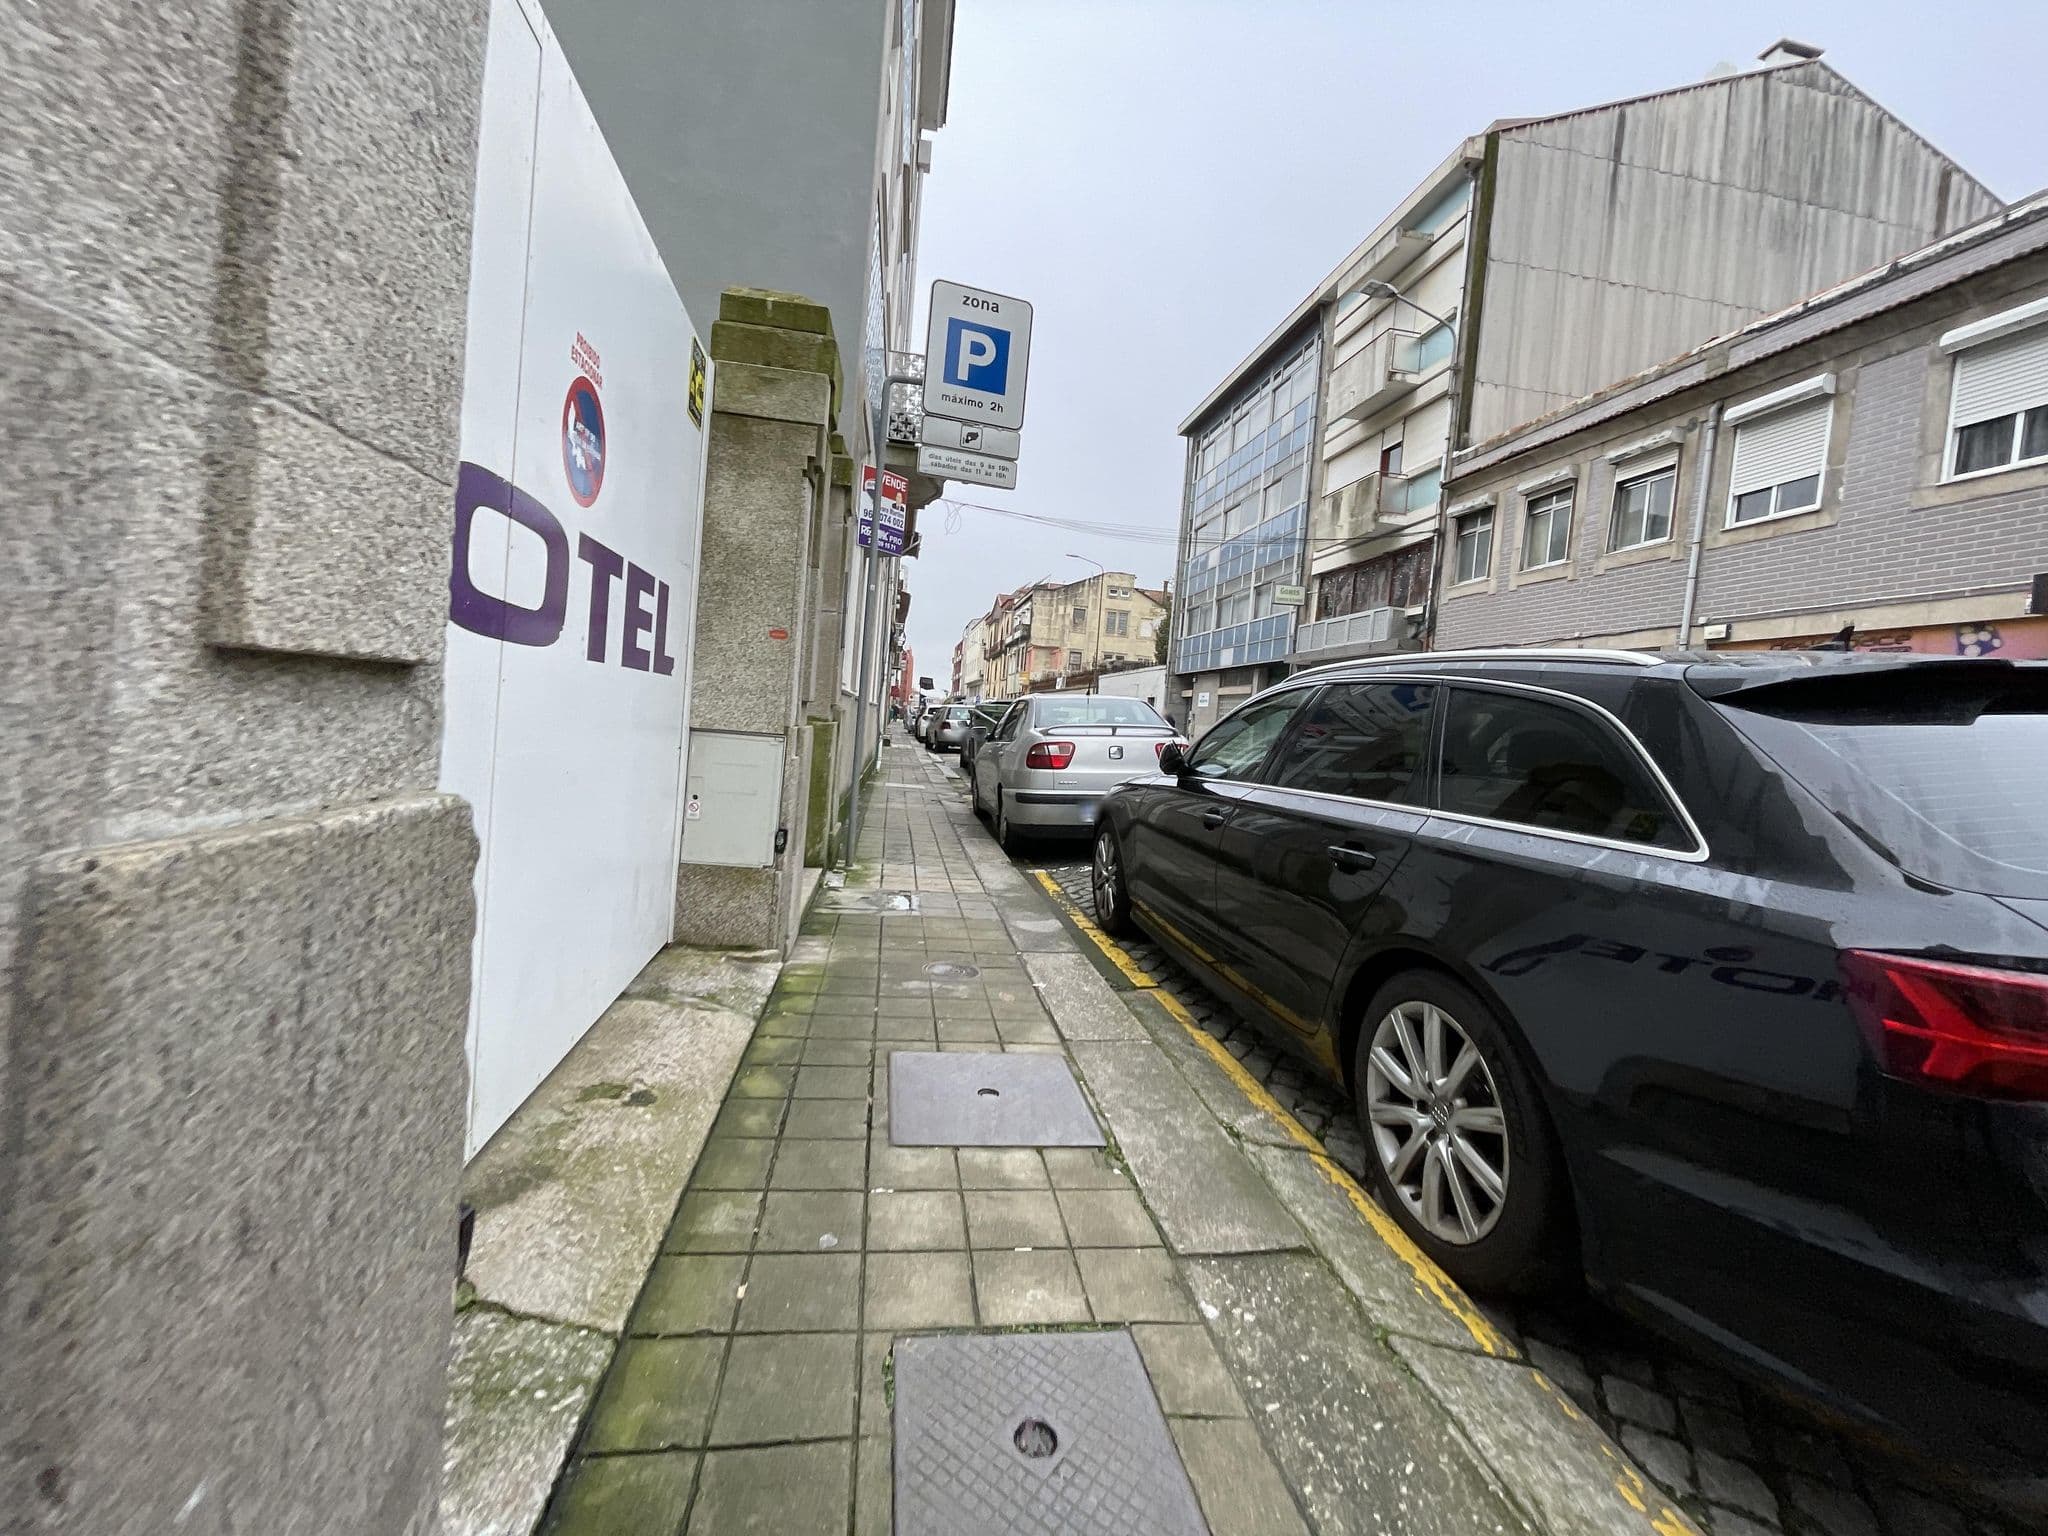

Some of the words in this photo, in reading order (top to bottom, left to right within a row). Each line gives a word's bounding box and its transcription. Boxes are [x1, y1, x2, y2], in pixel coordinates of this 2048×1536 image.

[962, 295, 1000, 313] zona
[957, 328, 997, 381] P
[941, 393, 983, 409] máximo
[990, 401, 1004, 413] 2h
